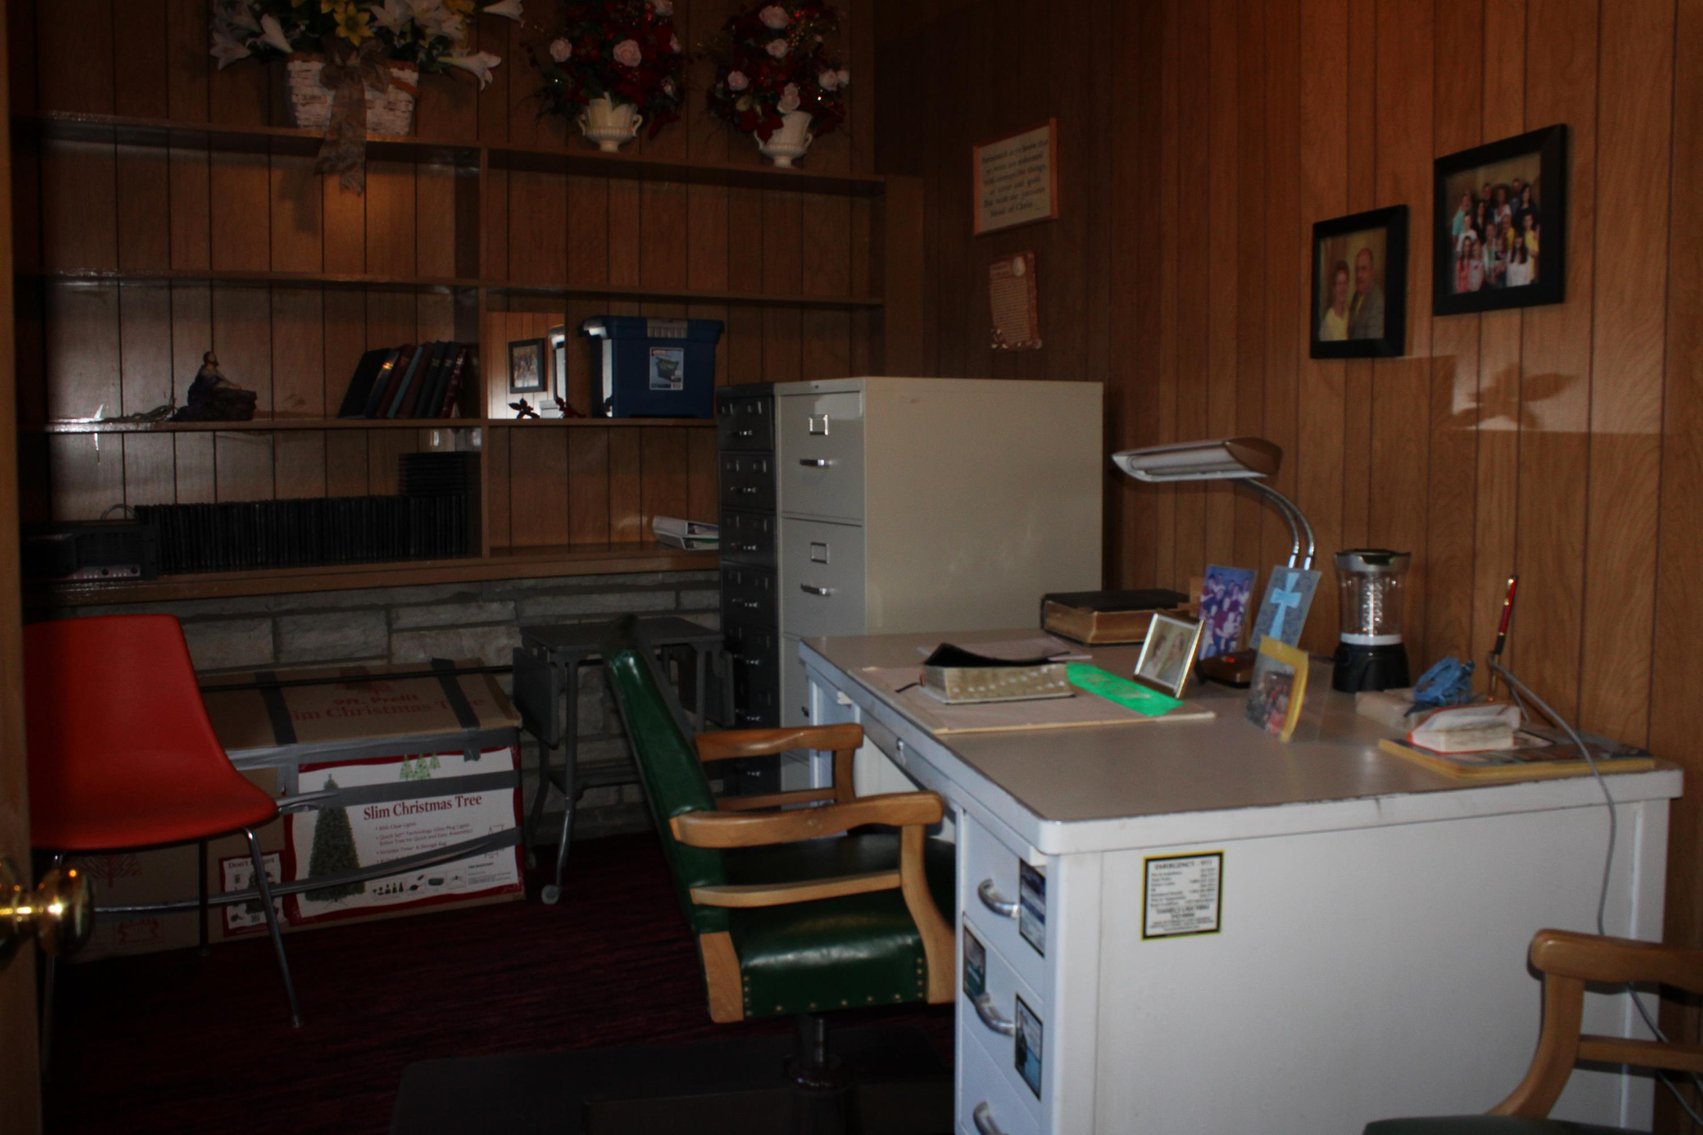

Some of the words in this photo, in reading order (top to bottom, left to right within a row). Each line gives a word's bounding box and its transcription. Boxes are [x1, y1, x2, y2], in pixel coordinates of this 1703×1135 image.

[326, 703, 431, 718] Christmas
[363, 805, 390, 820] Slim
[393, 800, 453, 817] Christmas
[454, 795, 483, 808] Tree
